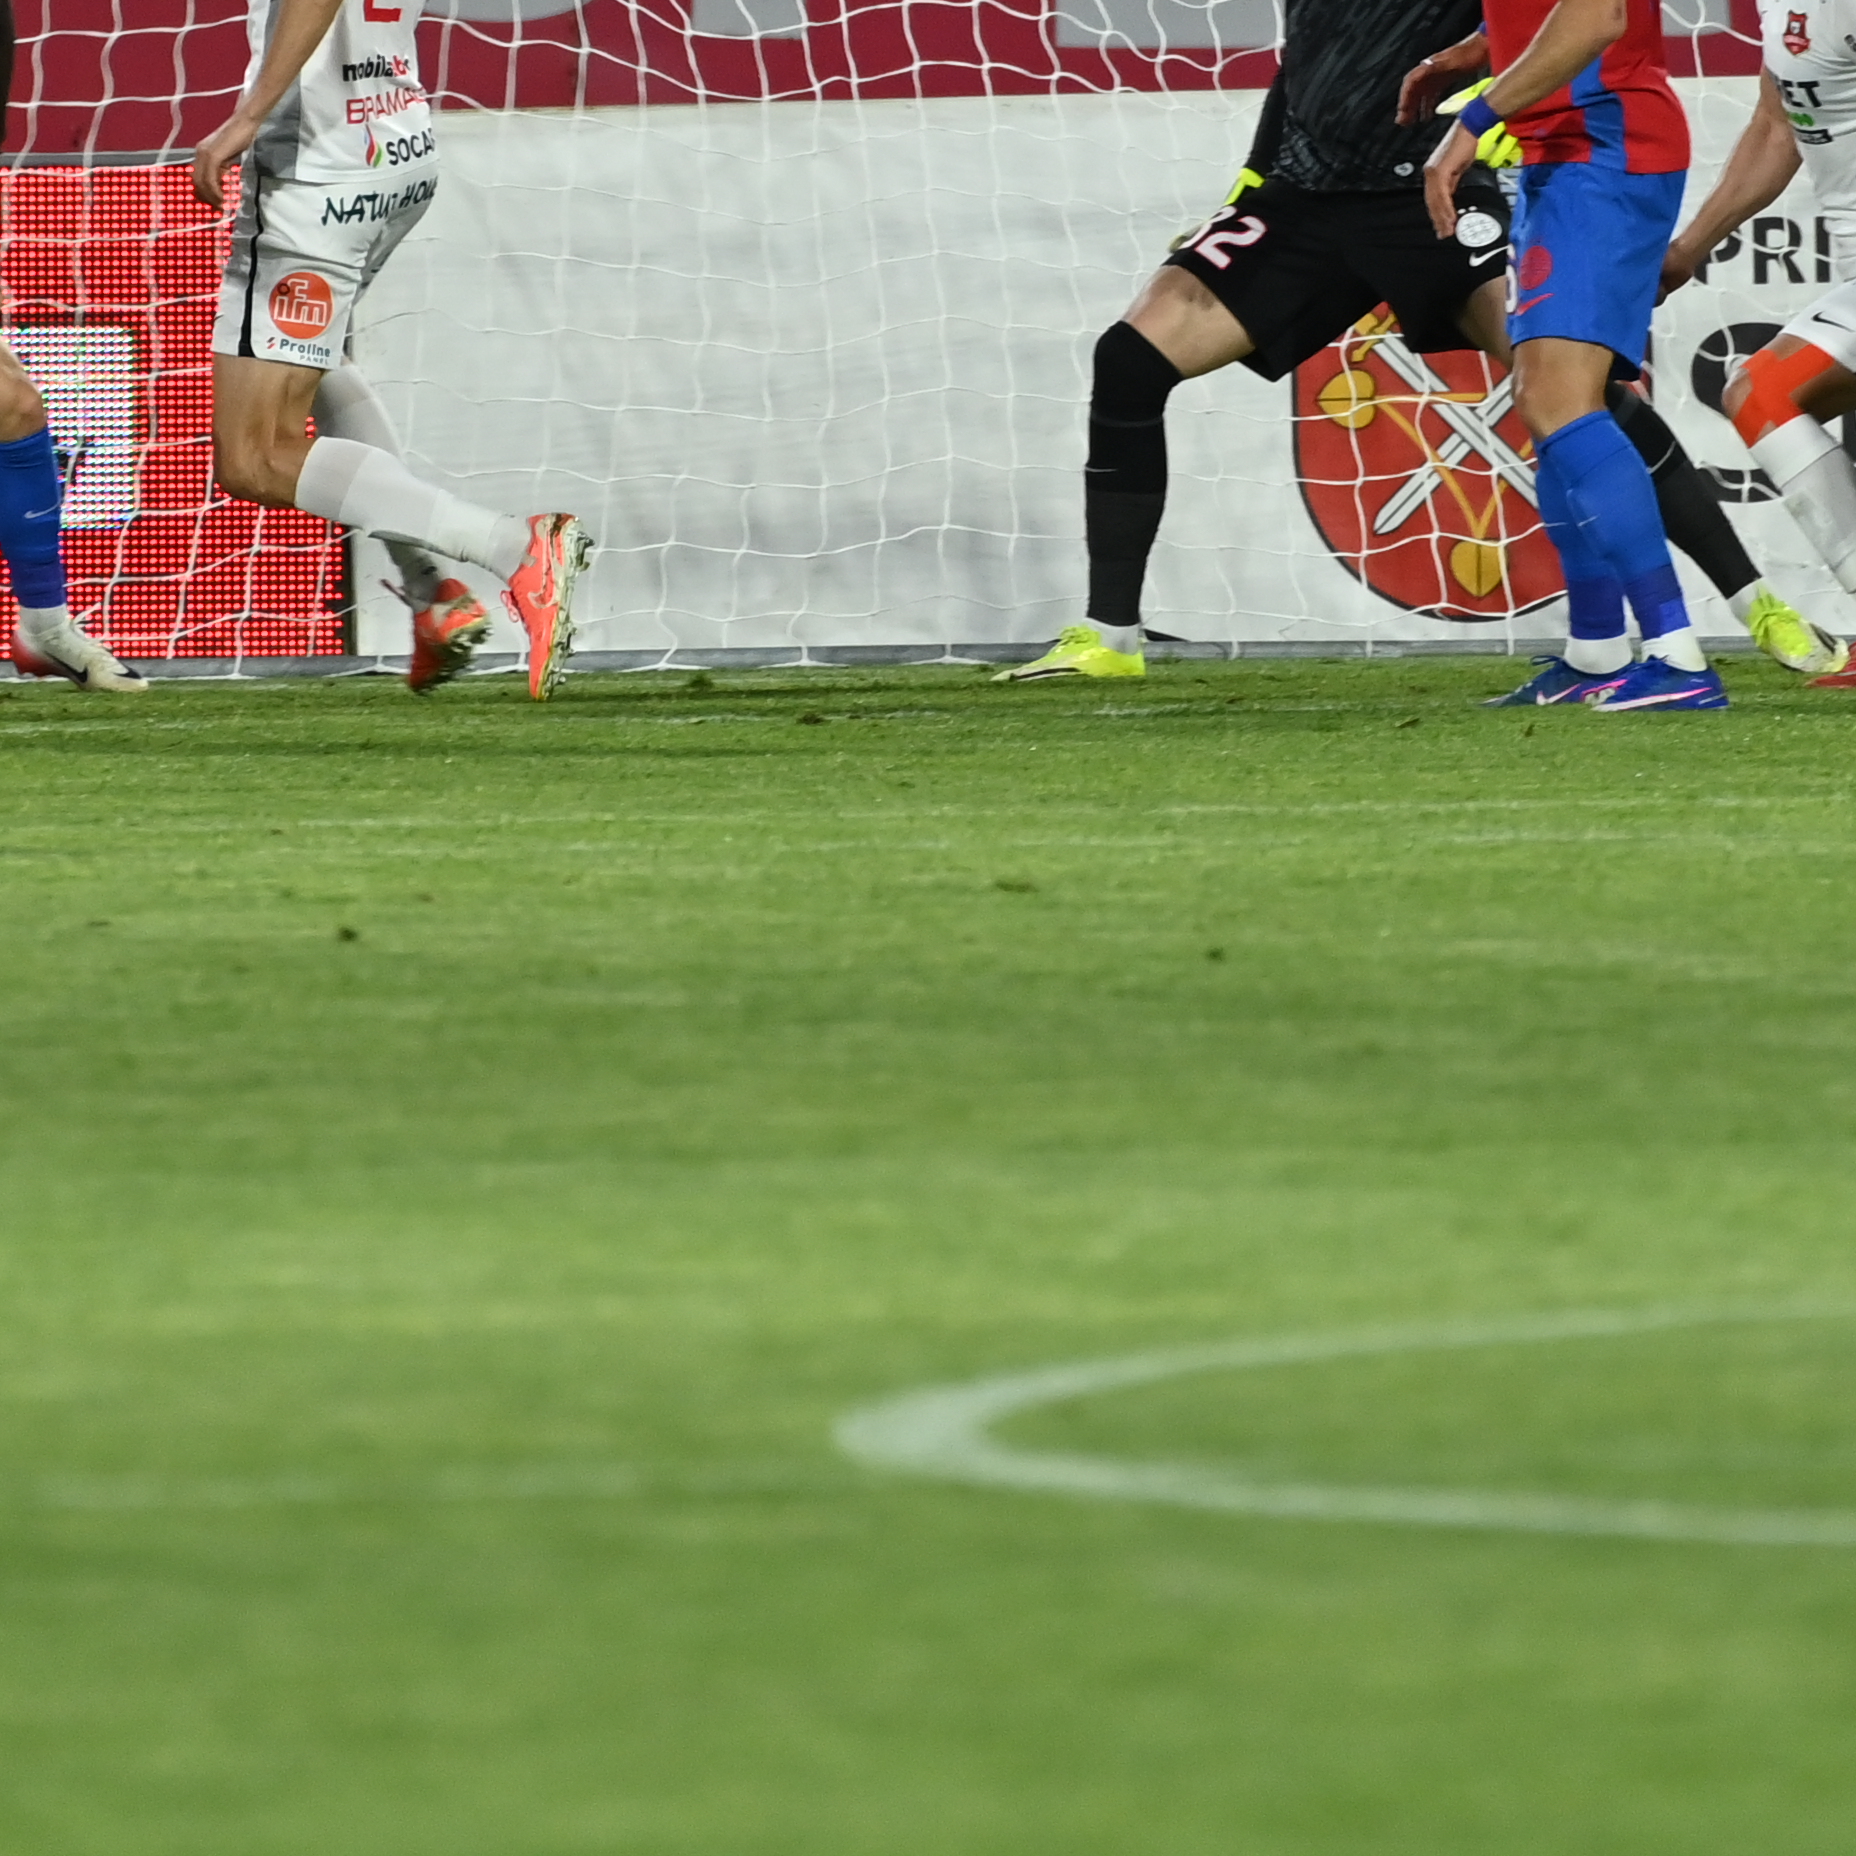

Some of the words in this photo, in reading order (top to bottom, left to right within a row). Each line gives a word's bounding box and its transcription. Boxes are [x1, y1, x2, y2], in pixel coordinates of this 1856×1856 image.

[385, 127, 436, 166] SOCA
[273, 277, 328, 327] ifm
[279, 338, 331, 358] Proline
